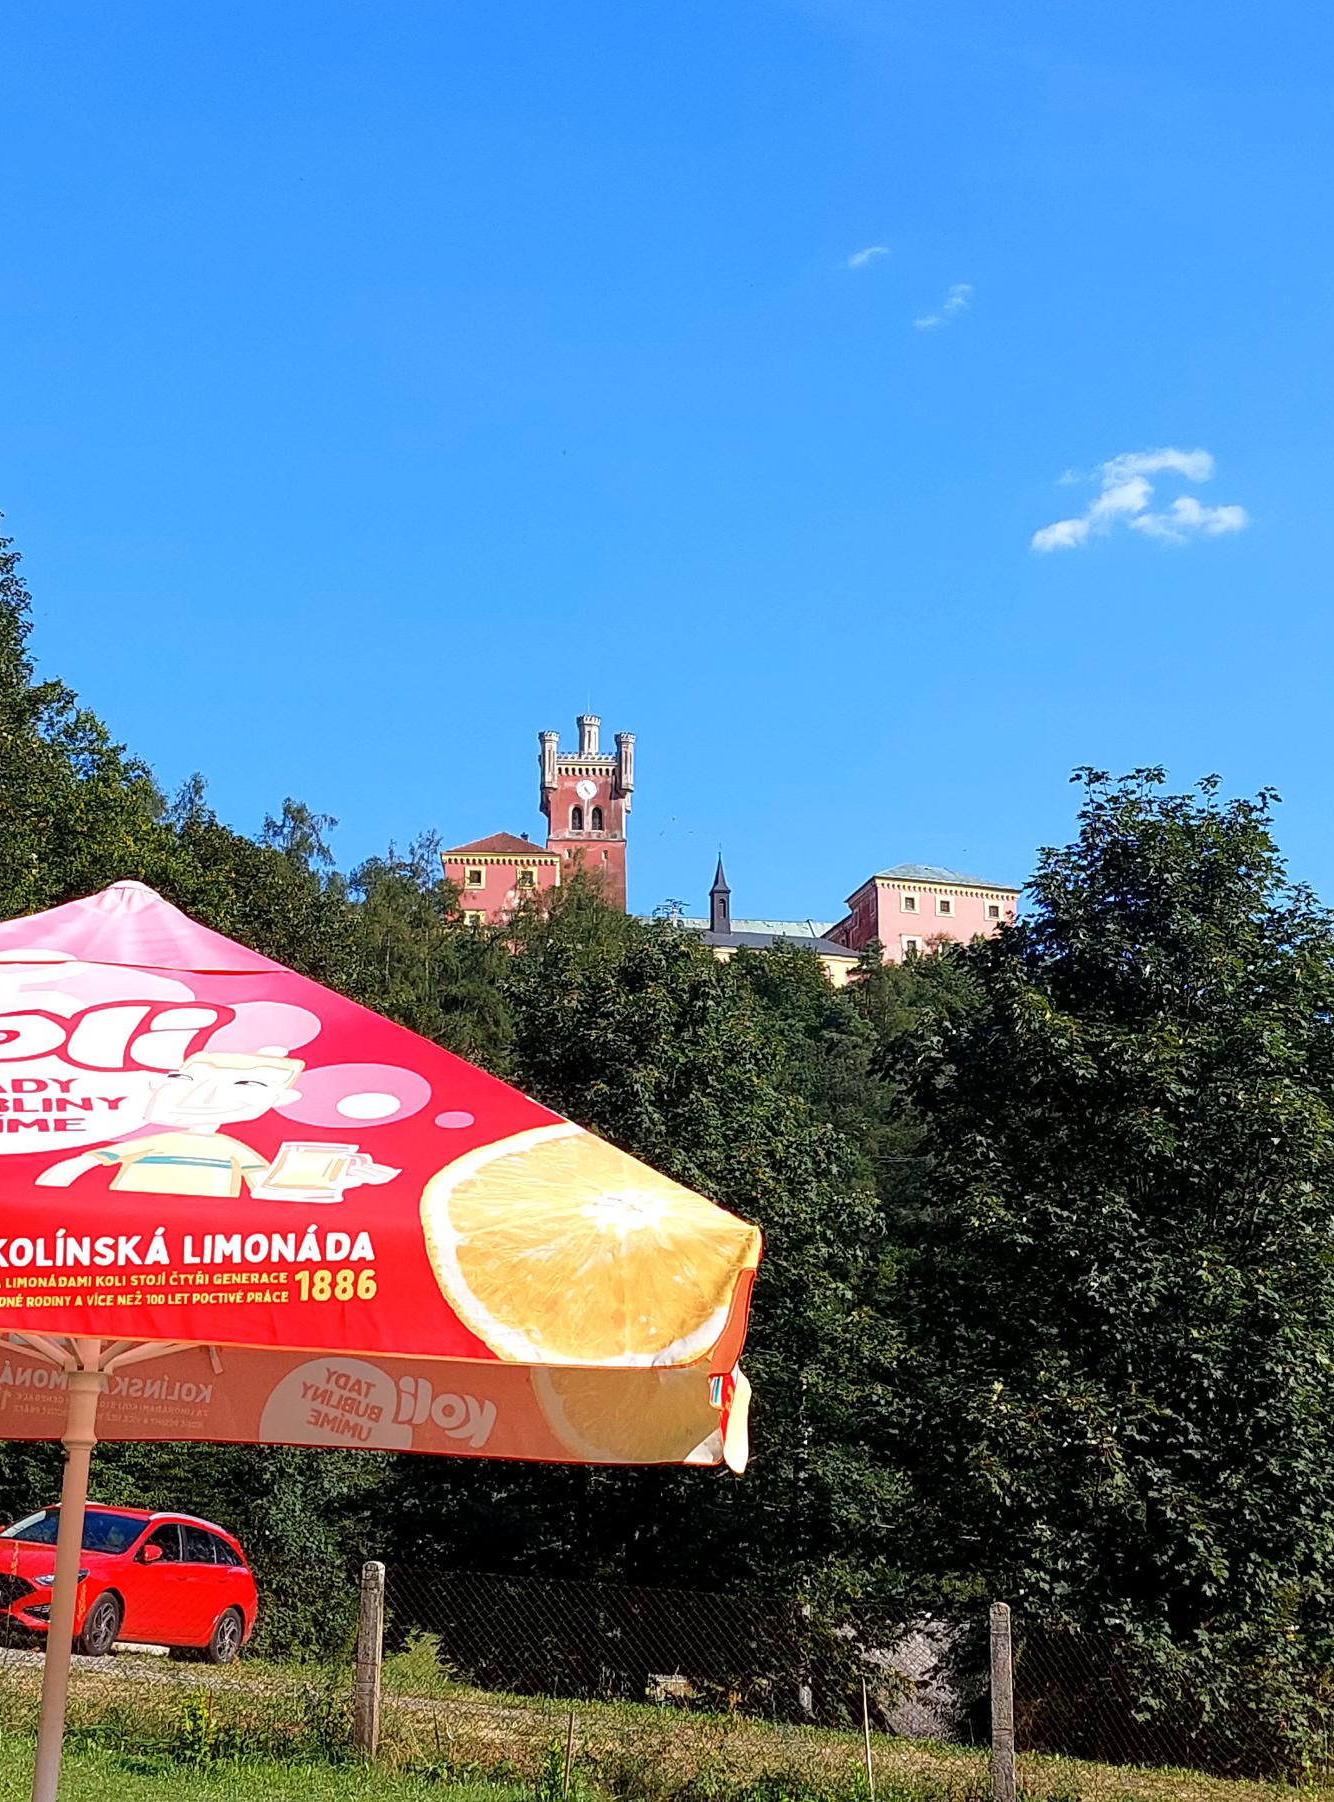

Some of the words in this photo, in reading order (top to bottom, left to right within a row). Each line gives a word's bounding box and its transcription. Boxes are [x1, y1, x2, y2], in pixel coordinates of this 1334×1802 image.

[183, 1224, 375, 1264] LIMONÁDA
[5, 1274, 91, 1288] LIMONÁDAMI
[96, 1275, 126, 1287] KOLI
[130, 1271, 166, 1286] STOJÍ
[169, 1271, 209, 1286] ČTYŘI
[213, 1272, 288, 1285] GENERACE
[294, 1269, 377, 1301] 1886
[26, 1295, 71, 1308] RODINY
[75, 1295, 83, 1307] A
[87, 1292, 114, 1306] VÍCE
[117, 1291, 142, 1306] NEŽ
[146, 1294, 165, 1305] 100
[168, 1293, 190, 1305] LET
[192, 1289, 244, 1304] POCTIVÉ
[246, 1289, 289, 1303] PRÁCE
